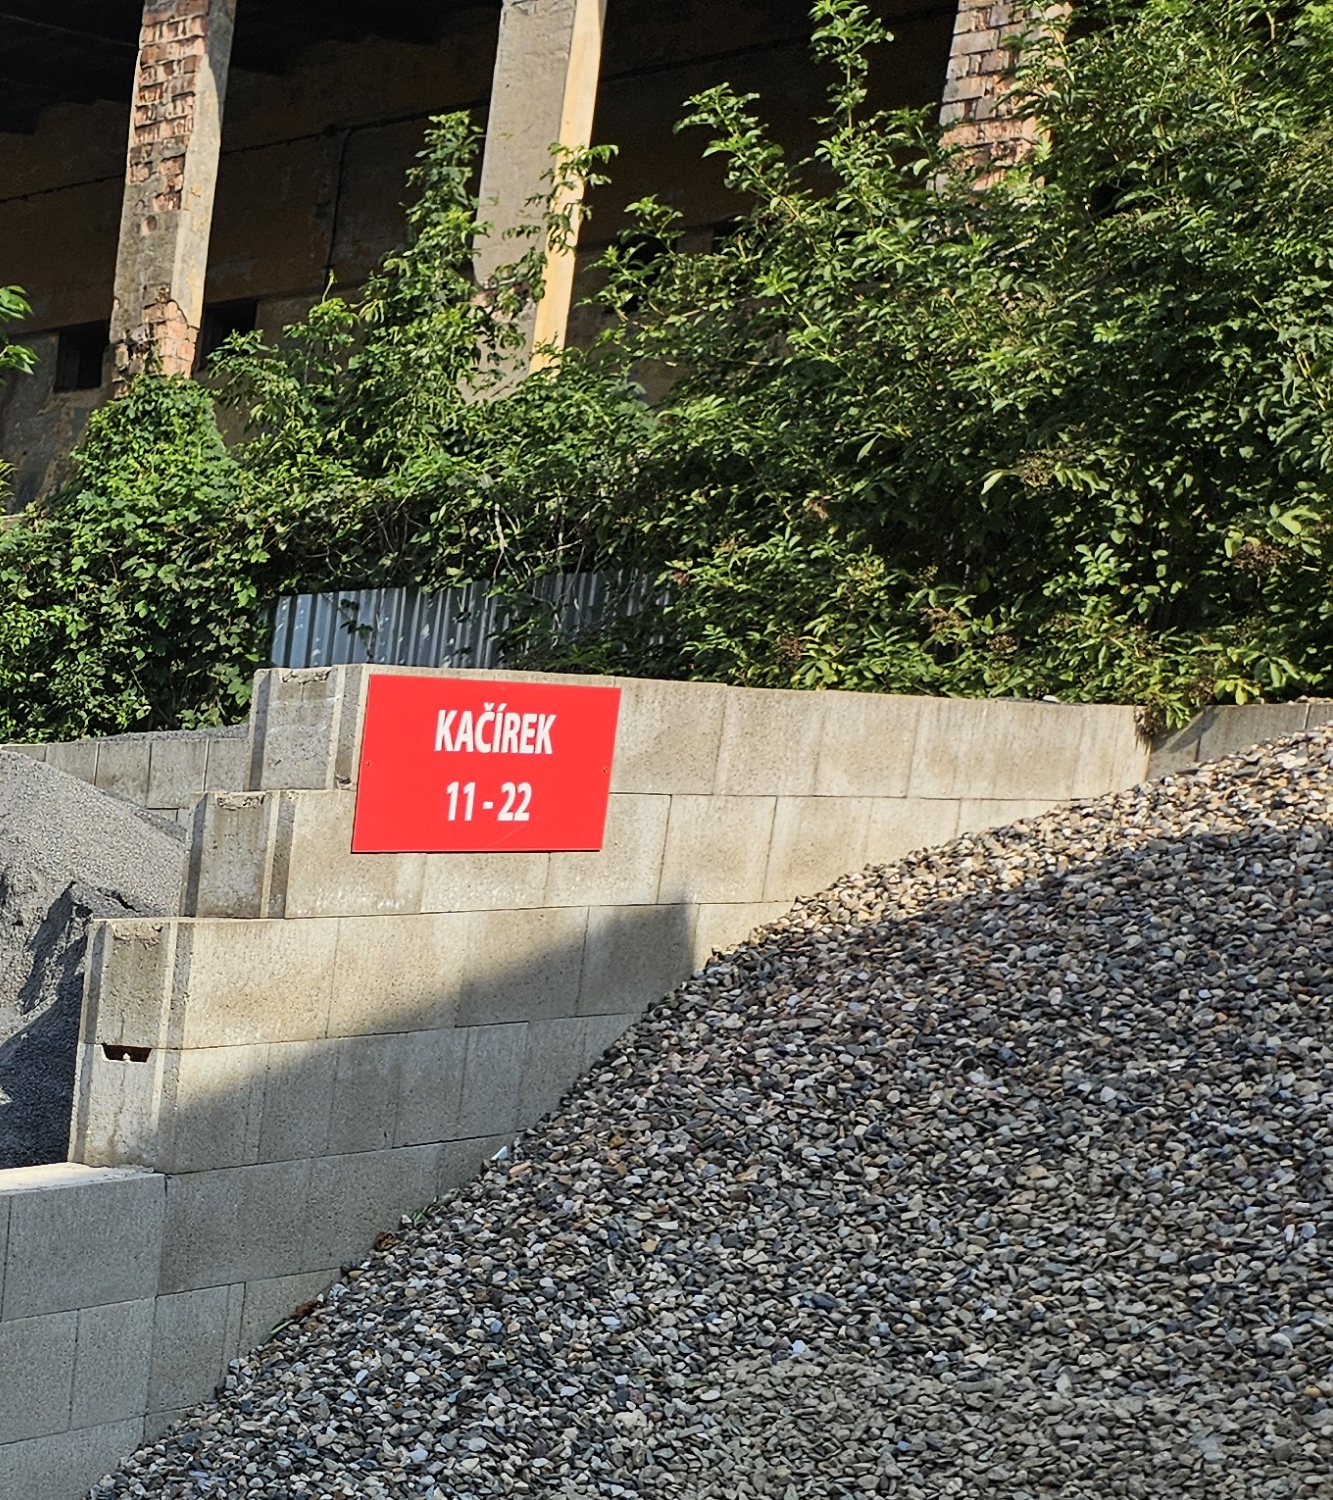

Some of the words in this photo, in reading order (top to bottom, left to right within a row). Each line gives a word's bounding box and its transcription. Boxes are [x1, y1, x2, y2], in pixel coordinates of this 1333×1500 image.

[434, 701, 557, 755] KAČÍREK
[446, 781, 476, 821] 11
[497, 781, 532, 822] 22
